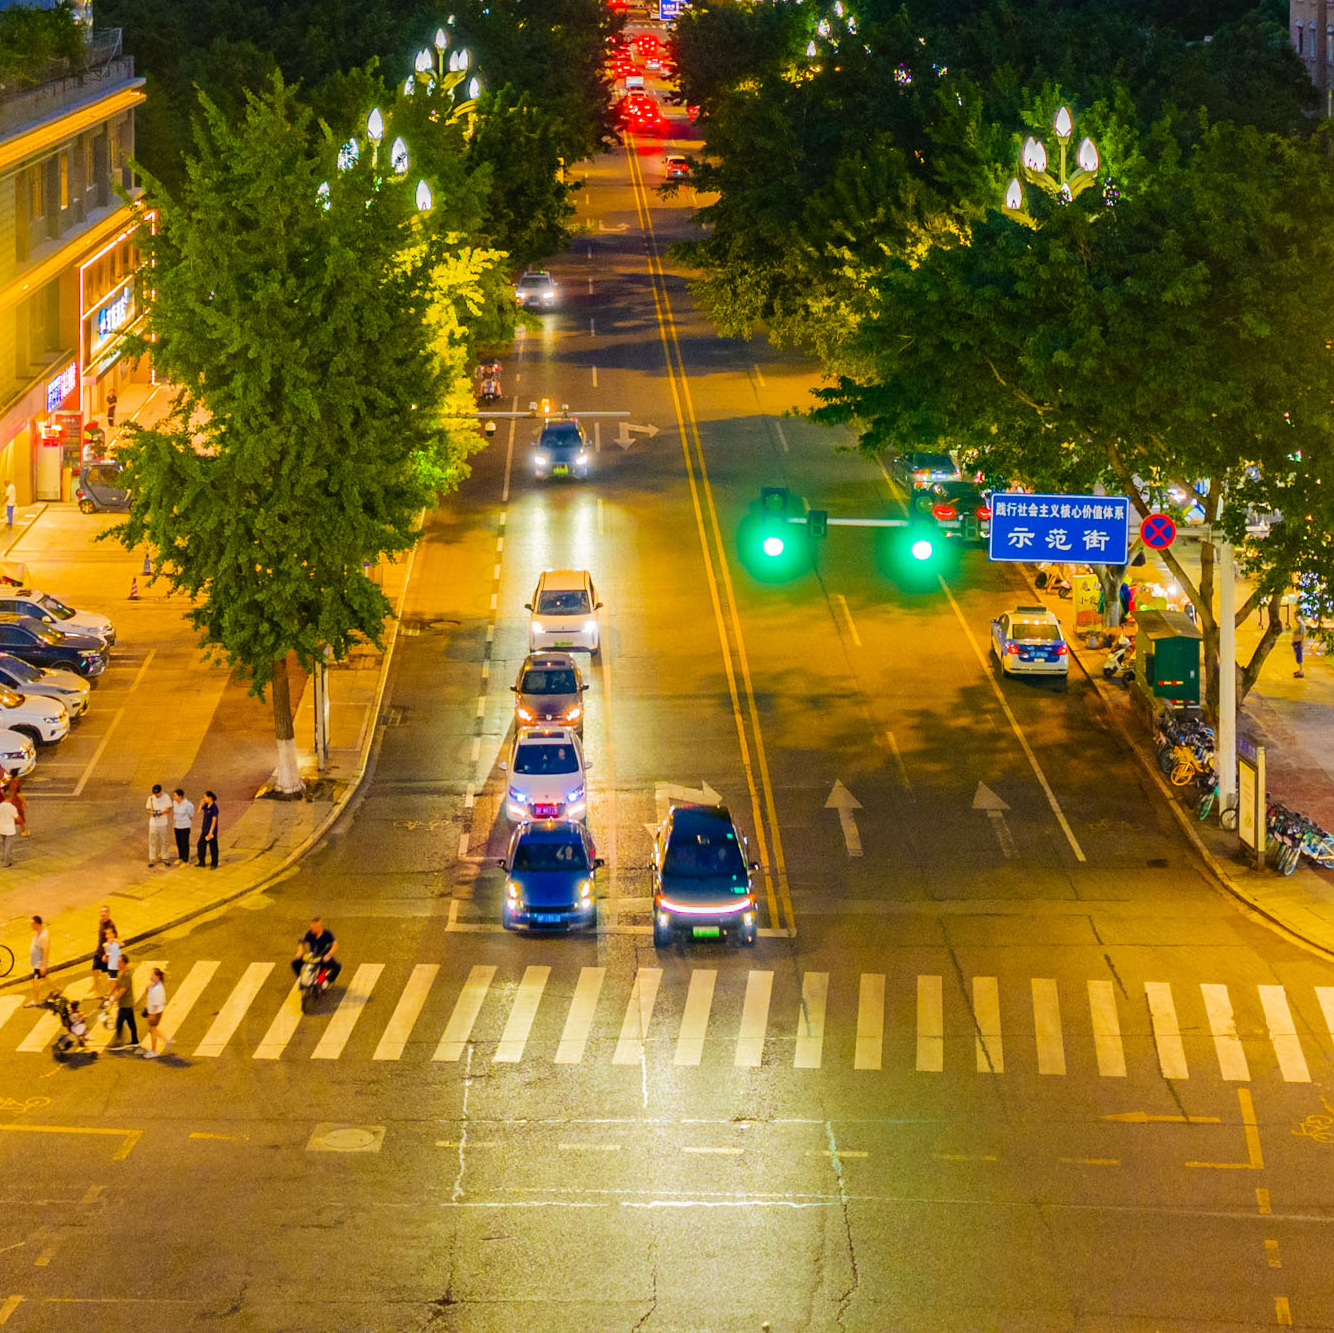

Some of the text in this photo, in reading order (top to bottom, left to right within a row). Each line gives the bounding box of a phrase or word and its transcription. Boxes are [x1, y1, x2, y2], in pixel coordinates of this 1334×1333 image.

[995, 501, 1125, 520] 践行社会主义核心价值体系
[1007, 527, 1111, 552] 示范街
